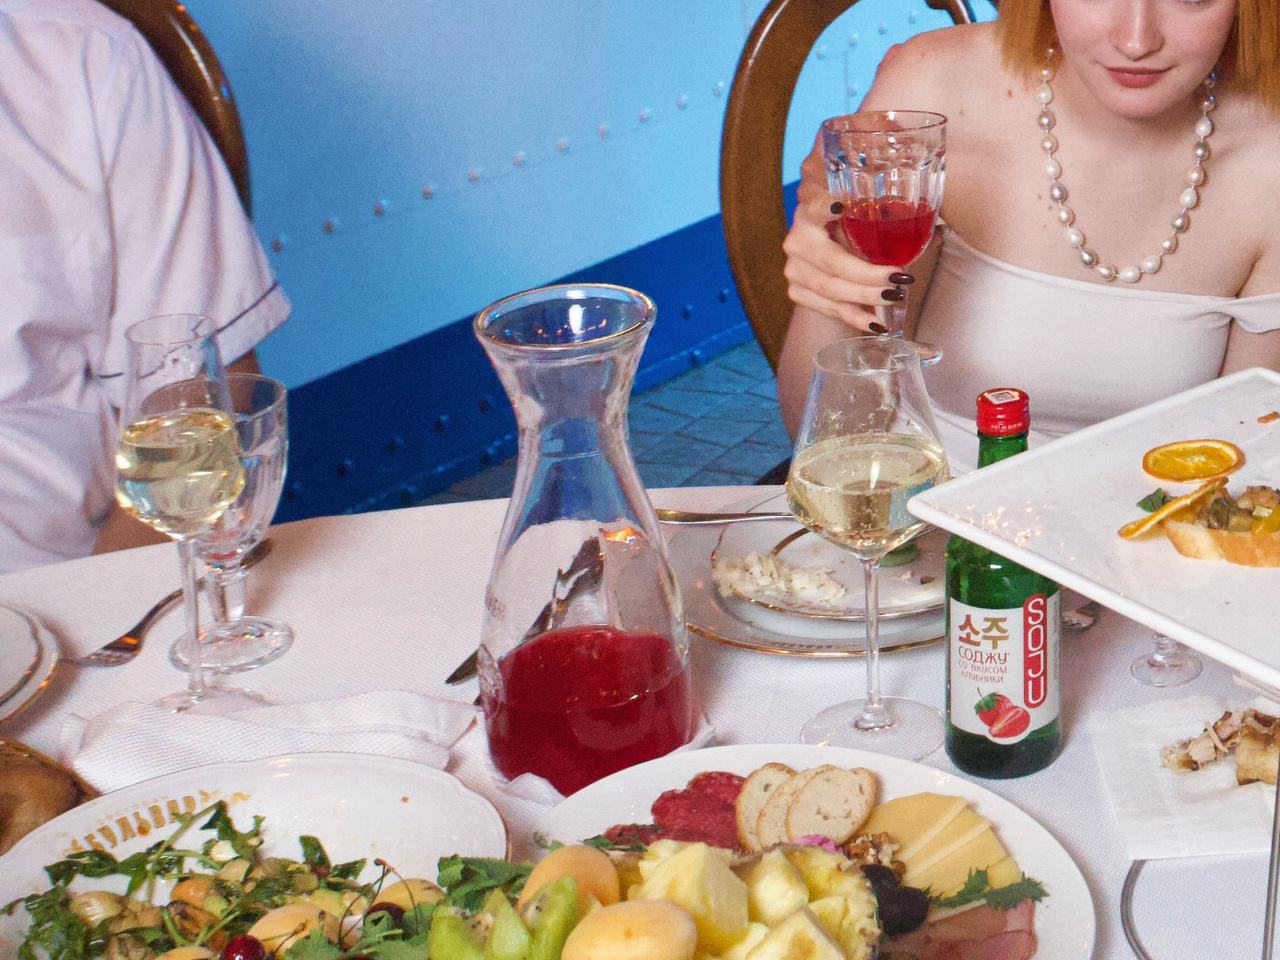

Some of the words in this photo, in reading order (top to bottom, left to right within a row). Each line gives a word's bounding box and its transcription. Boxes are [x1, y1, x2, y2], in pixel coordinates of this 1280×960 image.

[958, 614, 1010, 650] 소주
[971, 663, 1008, 674] ВКУСОМ
[1027, 597, 1045, 704] SOJU
